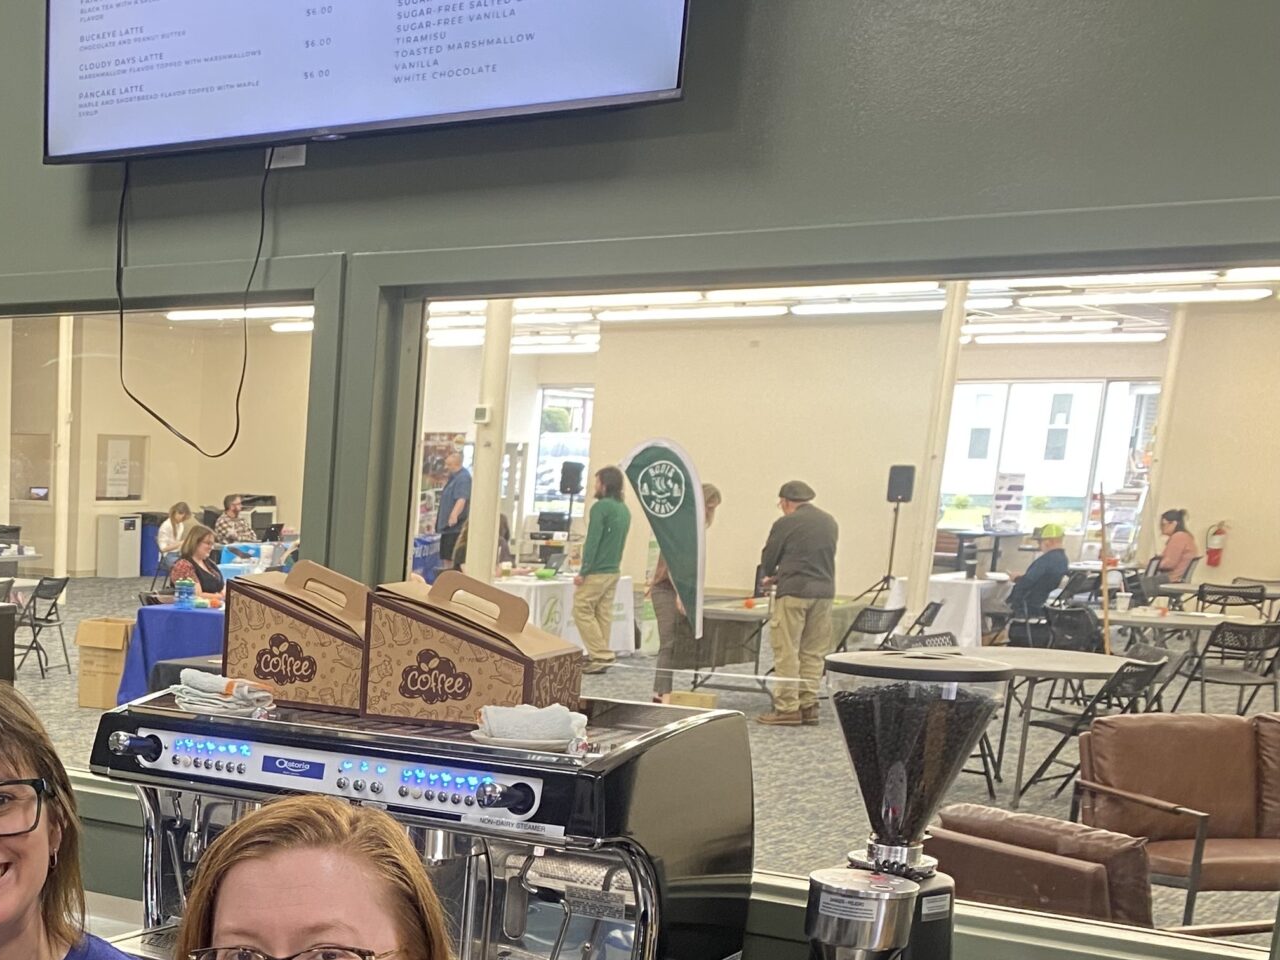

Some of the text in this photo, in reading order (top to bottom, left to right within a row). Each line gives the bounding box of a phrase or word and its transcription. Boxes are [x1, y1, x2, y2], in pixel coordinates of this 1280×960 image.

[80, 14, 104, 22] FLAVOR
[396, 2, 465, 20] SUGAR-FREE
[396, 8, 516, 33] SUGAR-FREE VANILLA
[80, 26, 144, 42] BUCKEYE LATTE
[396, 32, 447, 45] TIRAMISU
[395, 32, 535, 58] TOASTED MARSHMALLOW
[79, 52, 164, 72] CLOUDY DAYS LATTE
[394, 58, 439, 71] VANILLA
[394, 64, 497, 84] WHITE CHOCOLATE
[79, 85, 144, 100] PANCAKE LATTE
[650, 501, 674, 514] TRAIL
[480, 817, 546, 832] NON-DAIRY STEAMER
